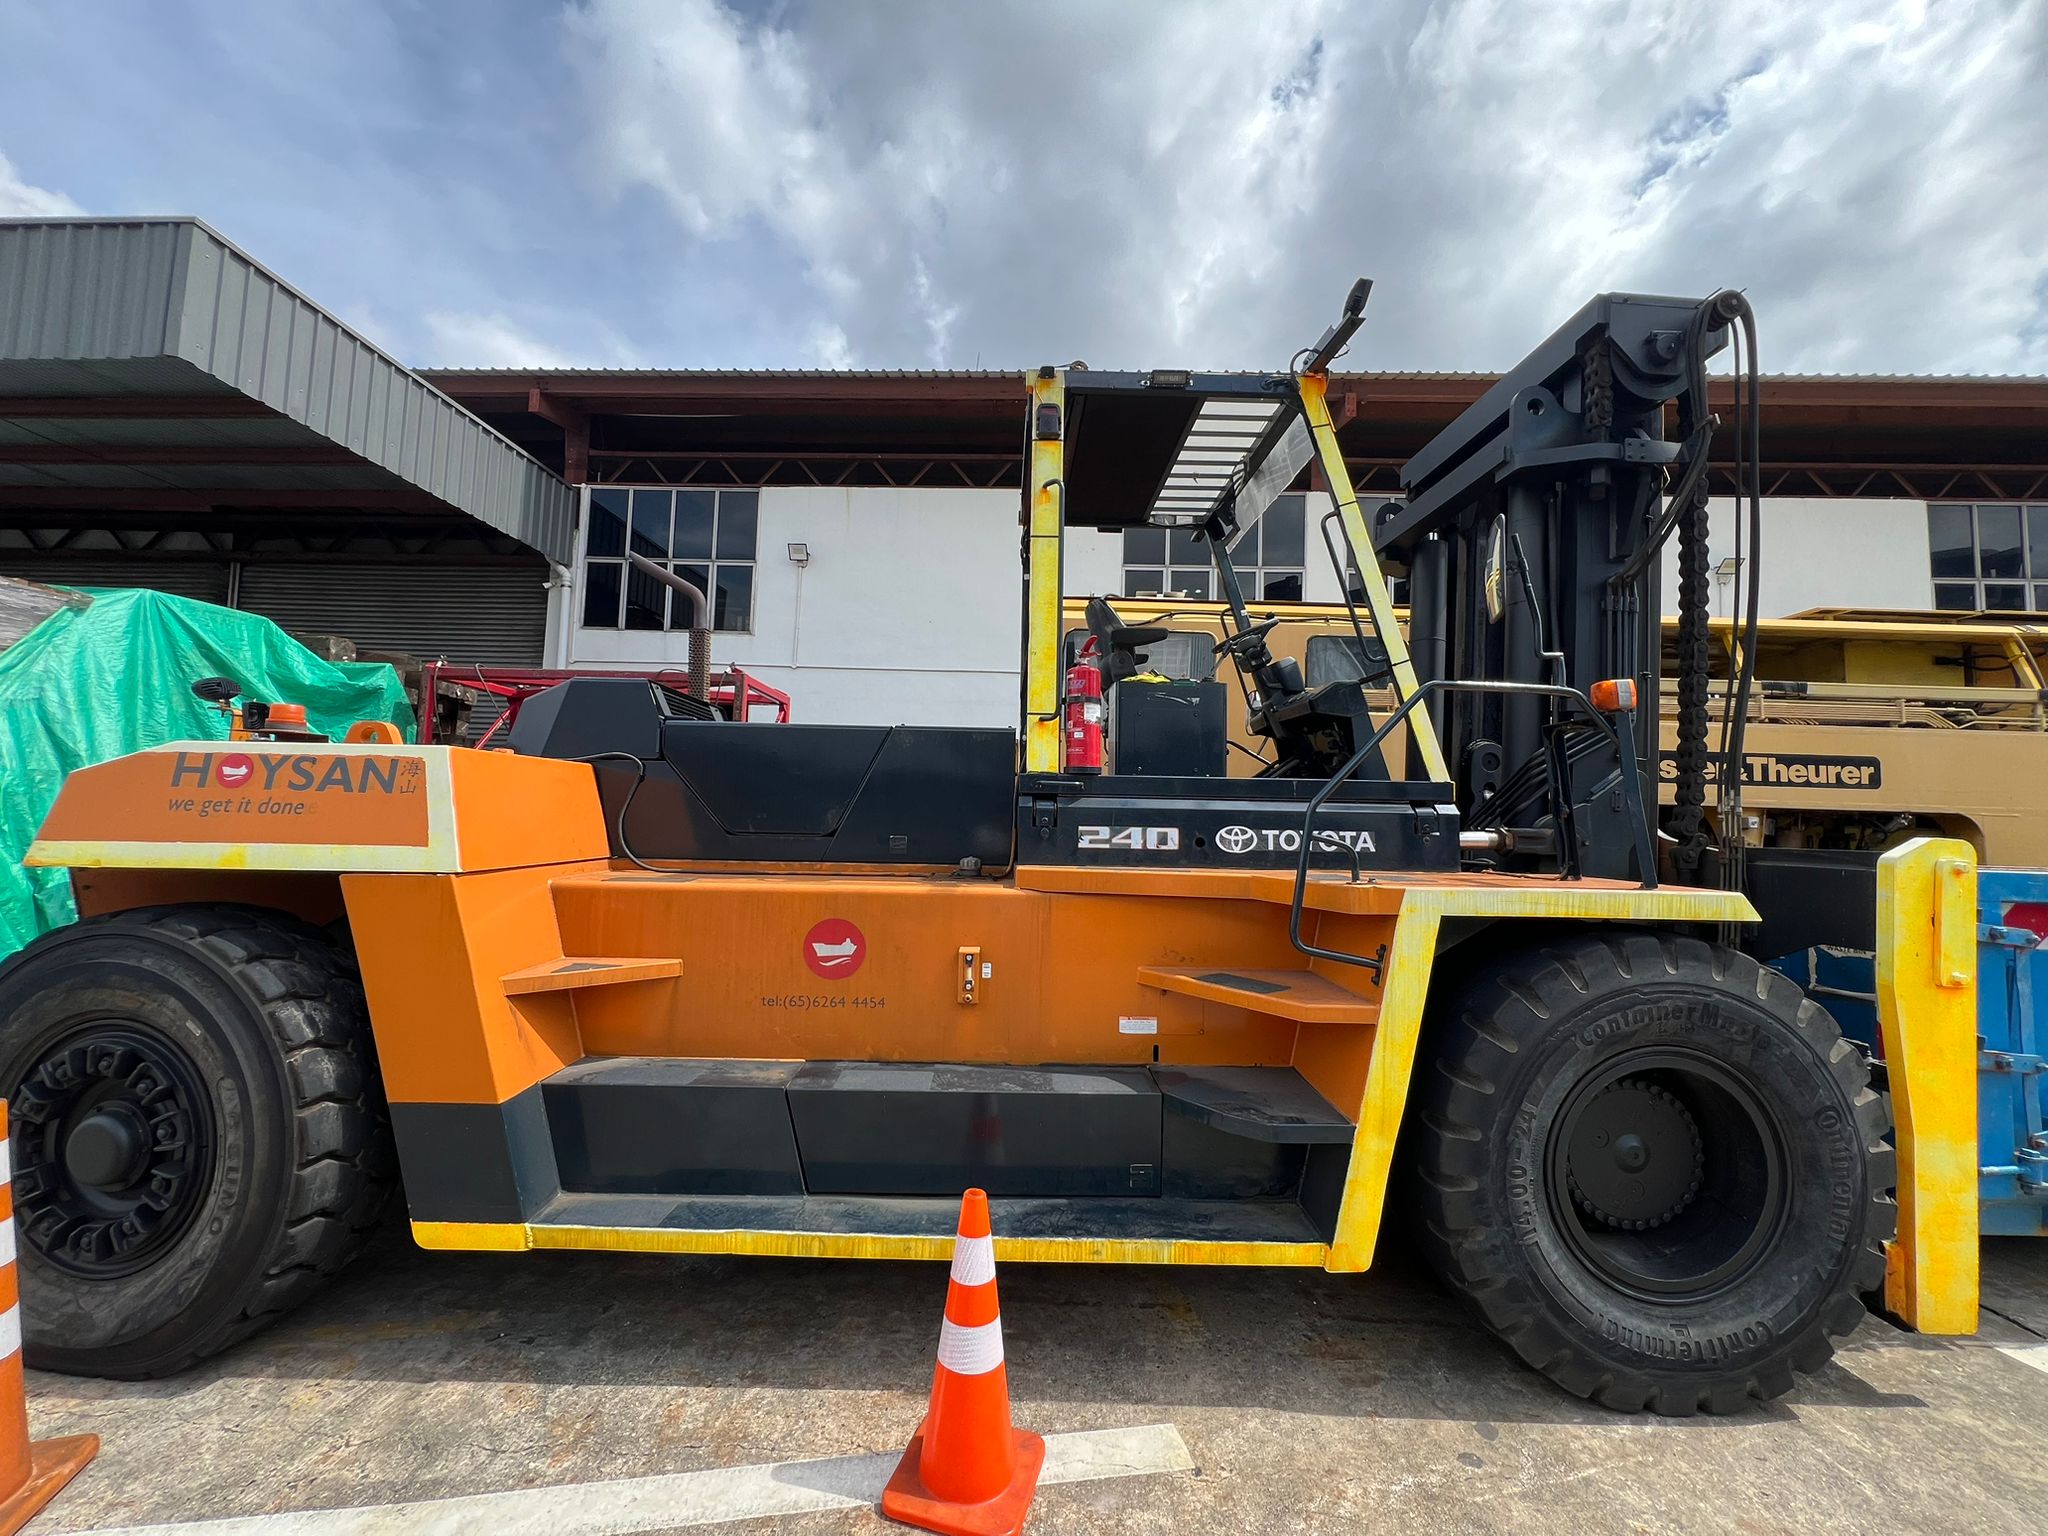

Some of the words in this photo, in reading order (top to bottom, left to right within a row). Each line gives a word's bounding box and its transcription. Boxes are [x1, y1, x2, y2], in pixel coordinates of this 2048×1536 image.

[168, 798, 195, 812] we
[198, 798, 232, 818] get
[237, 797, 253, 814] it
[257, 797, 305, 815] done
[1078, 825, 1180, 850] 240
[760, 994, 846, 1011] tel:(65)6264
[851, 996, 886, 1009] 4454
